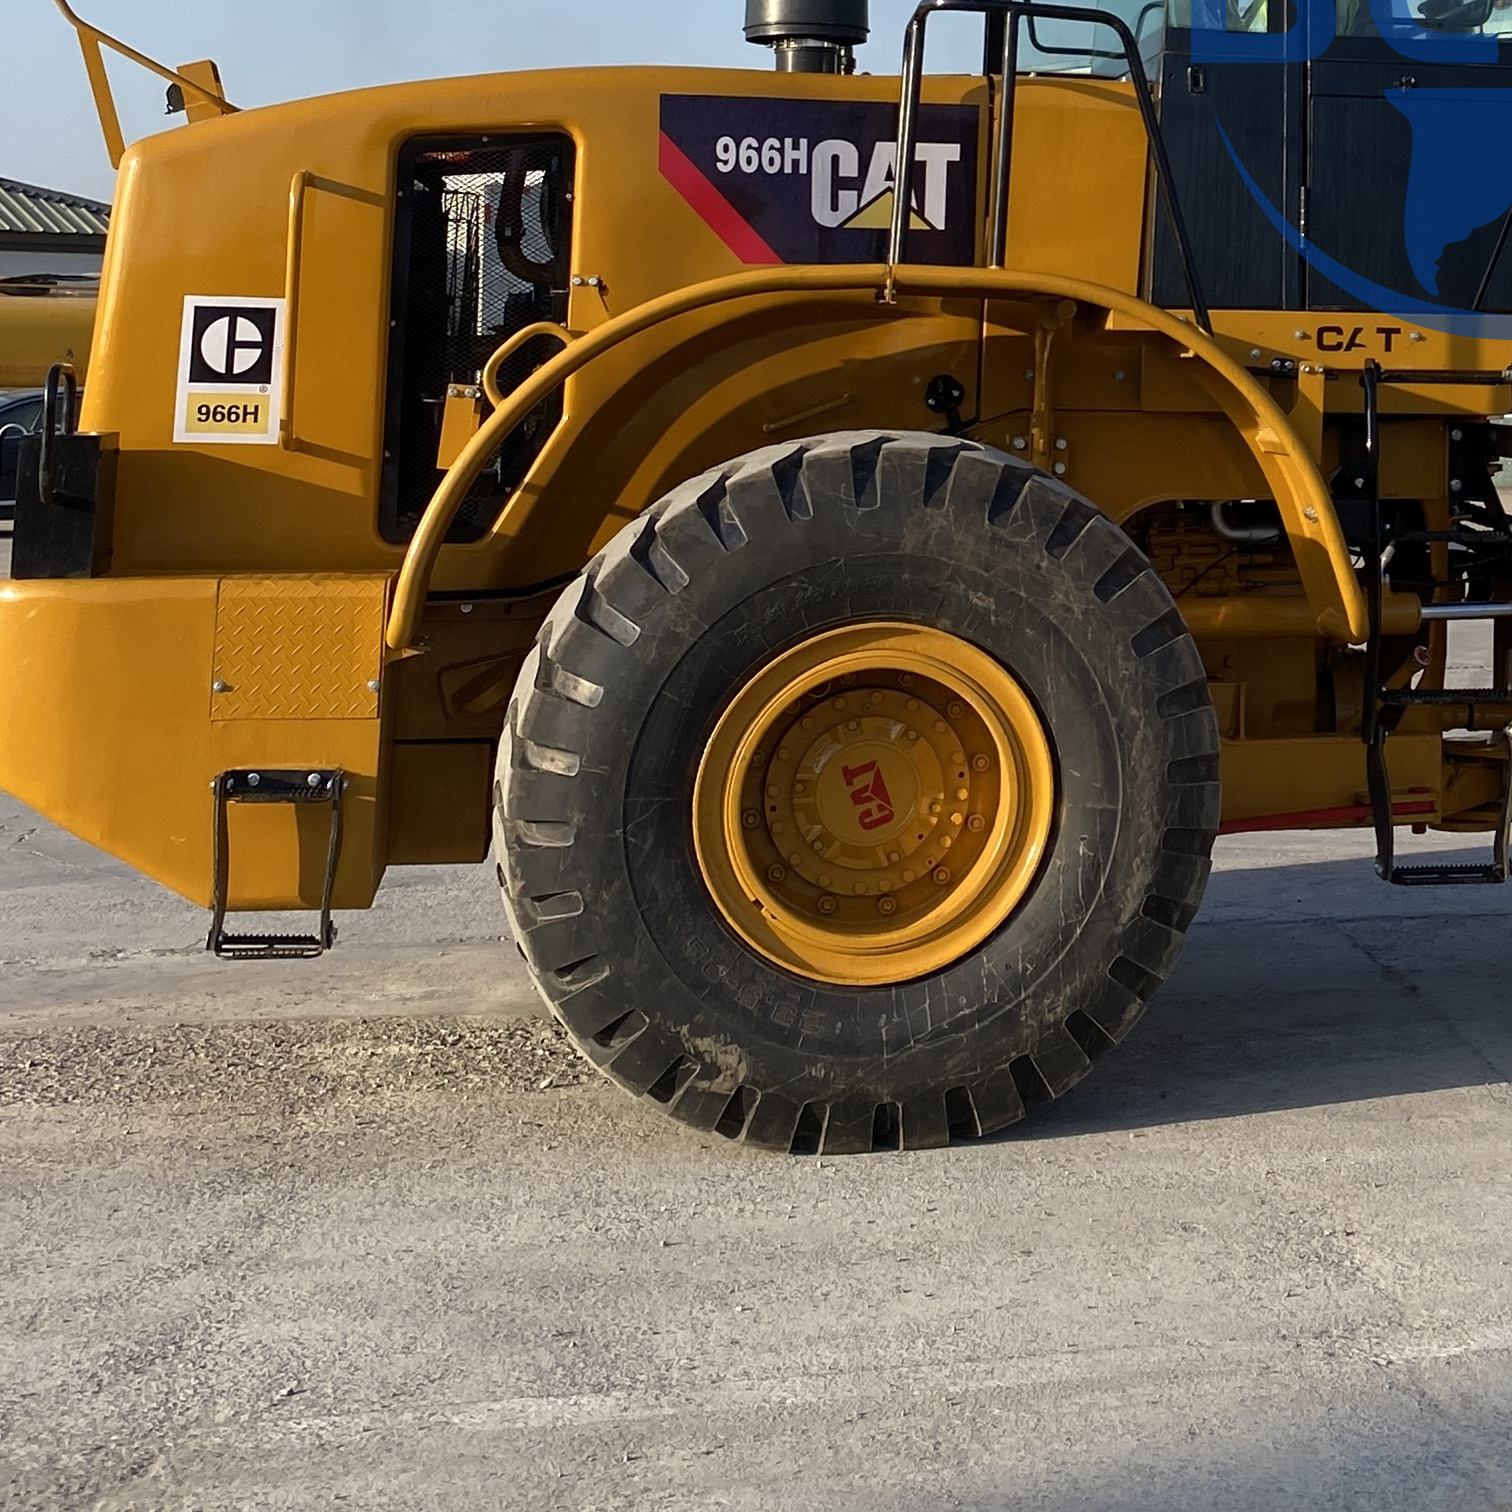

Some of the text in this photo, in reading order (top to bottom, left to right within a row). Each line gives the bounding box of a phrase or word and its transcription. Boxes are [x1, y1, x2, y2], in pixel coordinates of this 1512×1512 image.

[715, 136, 961, 230] 966H CAT
[1316, 326, 1402, 352] CAT
[197, 404, 260, 423] 966H
[841, 759, 895, 830] CAT
